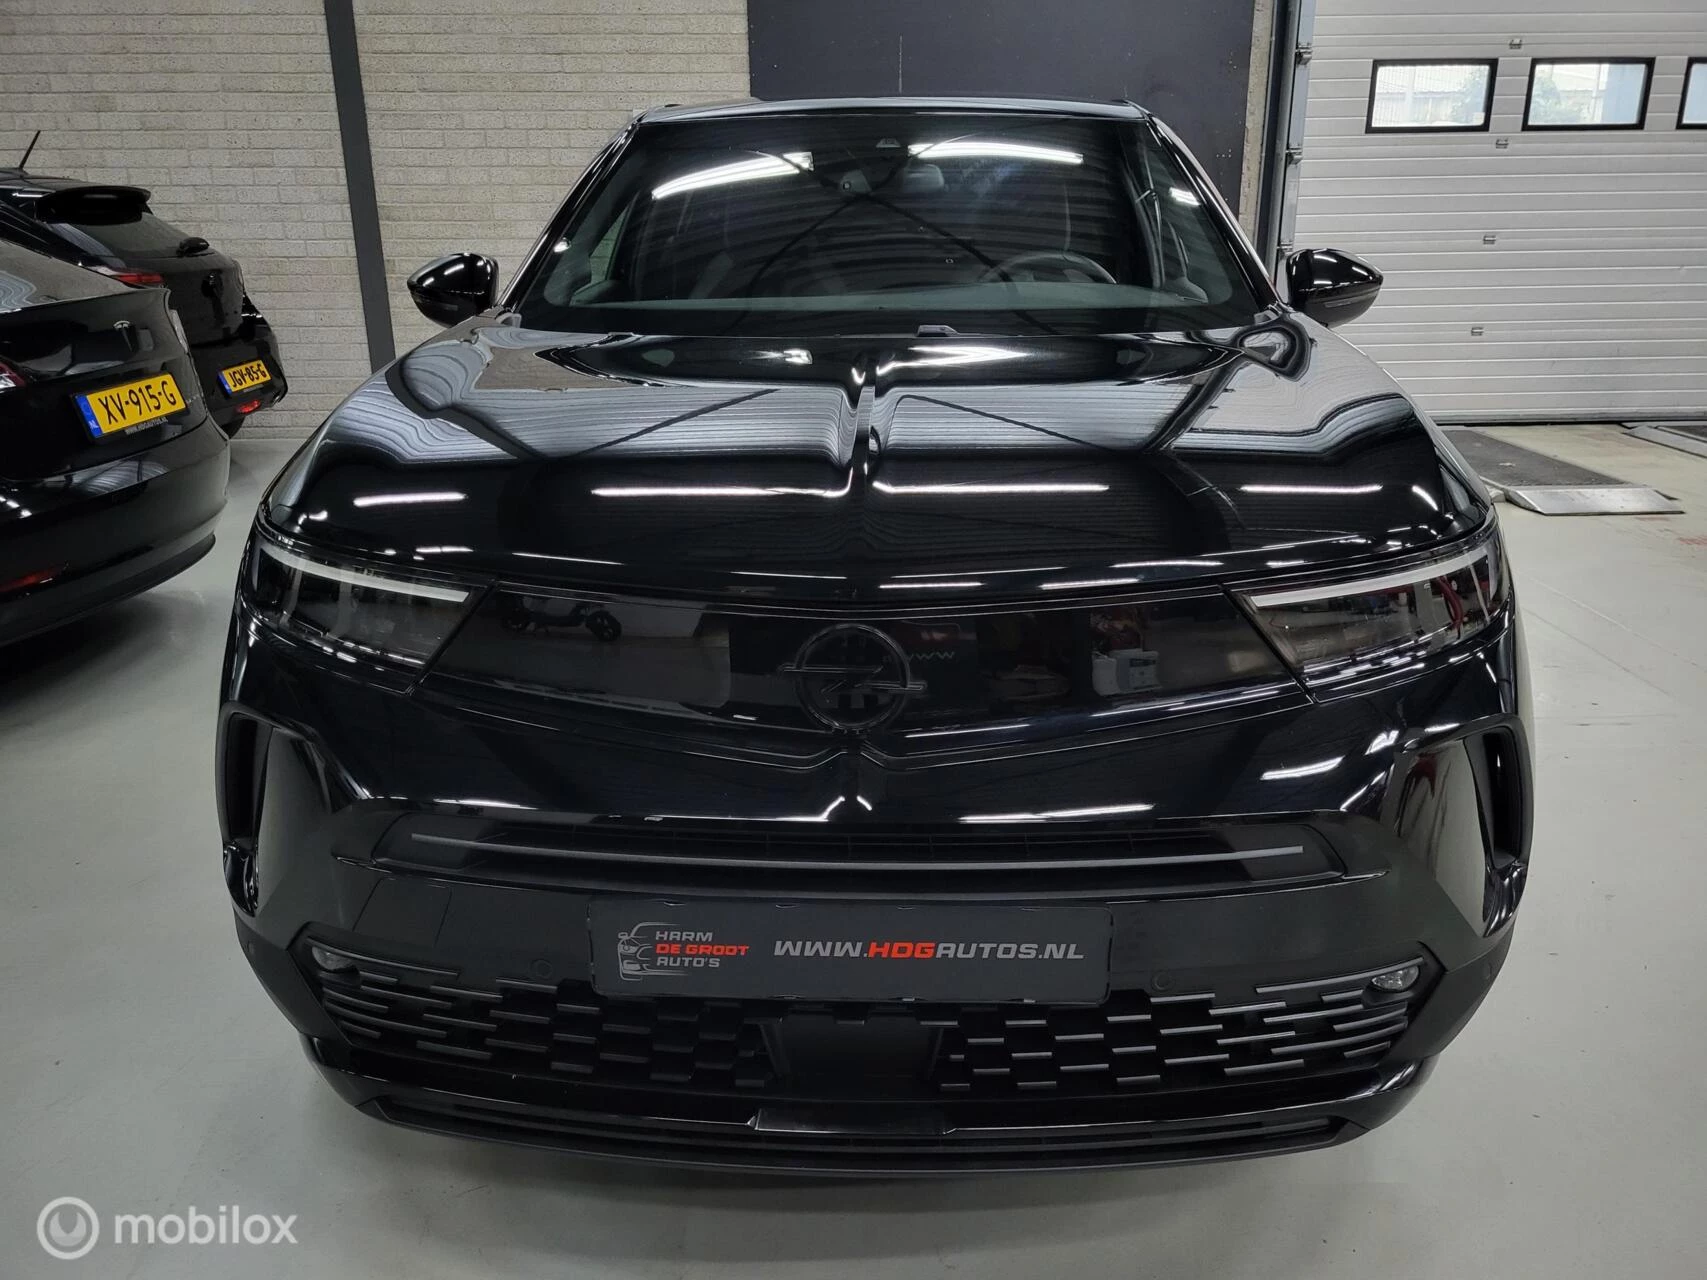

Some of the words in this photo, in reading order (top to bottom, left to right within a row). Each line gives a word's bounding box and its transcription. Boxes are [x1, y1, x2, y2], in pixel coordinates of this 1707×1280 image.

[229, 363, 267, 388] JGV-85-G
[98, 380, 177, 425] XV-915-G
[655, 931, 713, 942] HARM
[655, 943, 682, 955] DE
[685, 944, 750, 956] GROOT
[773, 940, 1084, 959] WWW.HDGAUTOS.NL
[656, 956, 721, 968] AUTO'S
